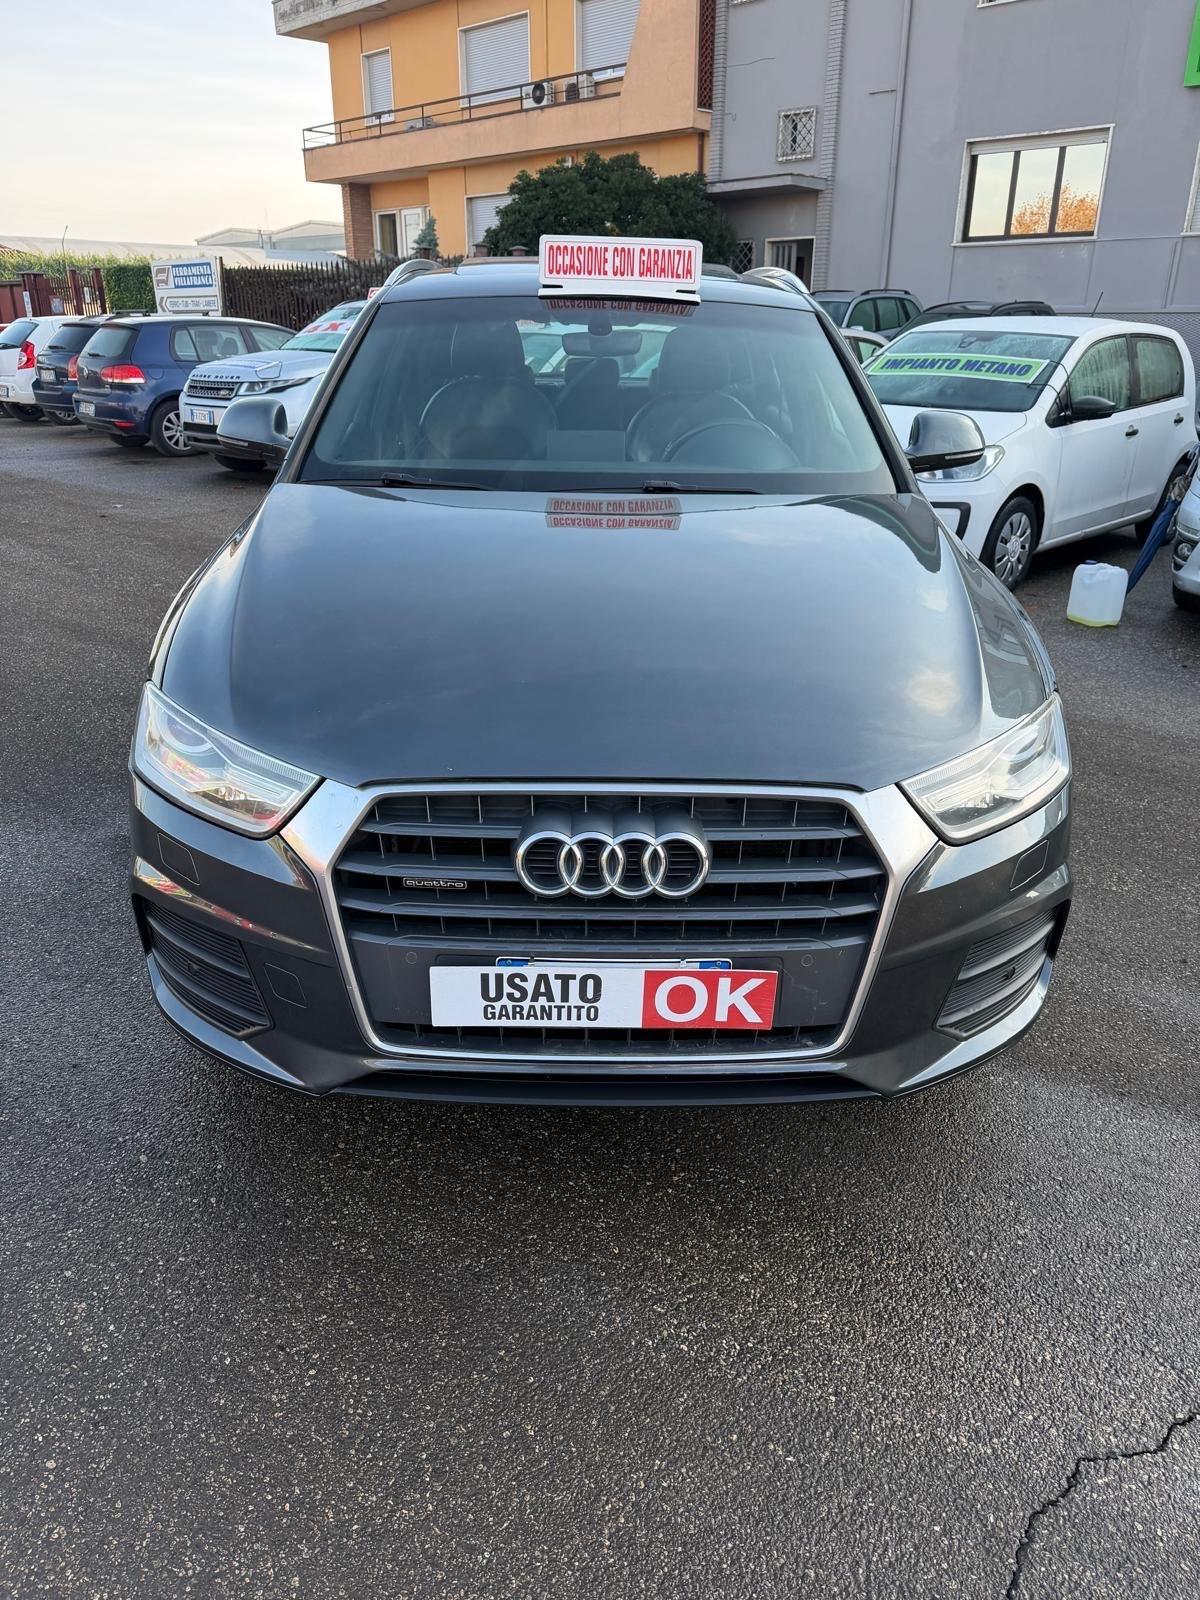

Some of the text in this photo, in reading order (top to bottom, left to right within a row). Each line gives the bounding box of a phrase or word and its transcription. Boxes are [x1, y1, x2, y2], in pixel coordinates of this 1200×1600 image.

[548, 244, 693, 279] OCCASIONE CON GARANZIA
[172, 265, 211, 277] FERRAMENTA
[174, 275, 213, 287] VILLAFRANCA
[879, 358, 1033, 377] IMPIANTO METANO
[553, 499, 673, 513] OCCASIONE CON GARANZIA
[406, 880, 464, 888] quattro
[480, 972, 603, 1004] USATO
[654, 975, 768, 1024] OK
[482, 1004, 599, 1022] GARANTITO
